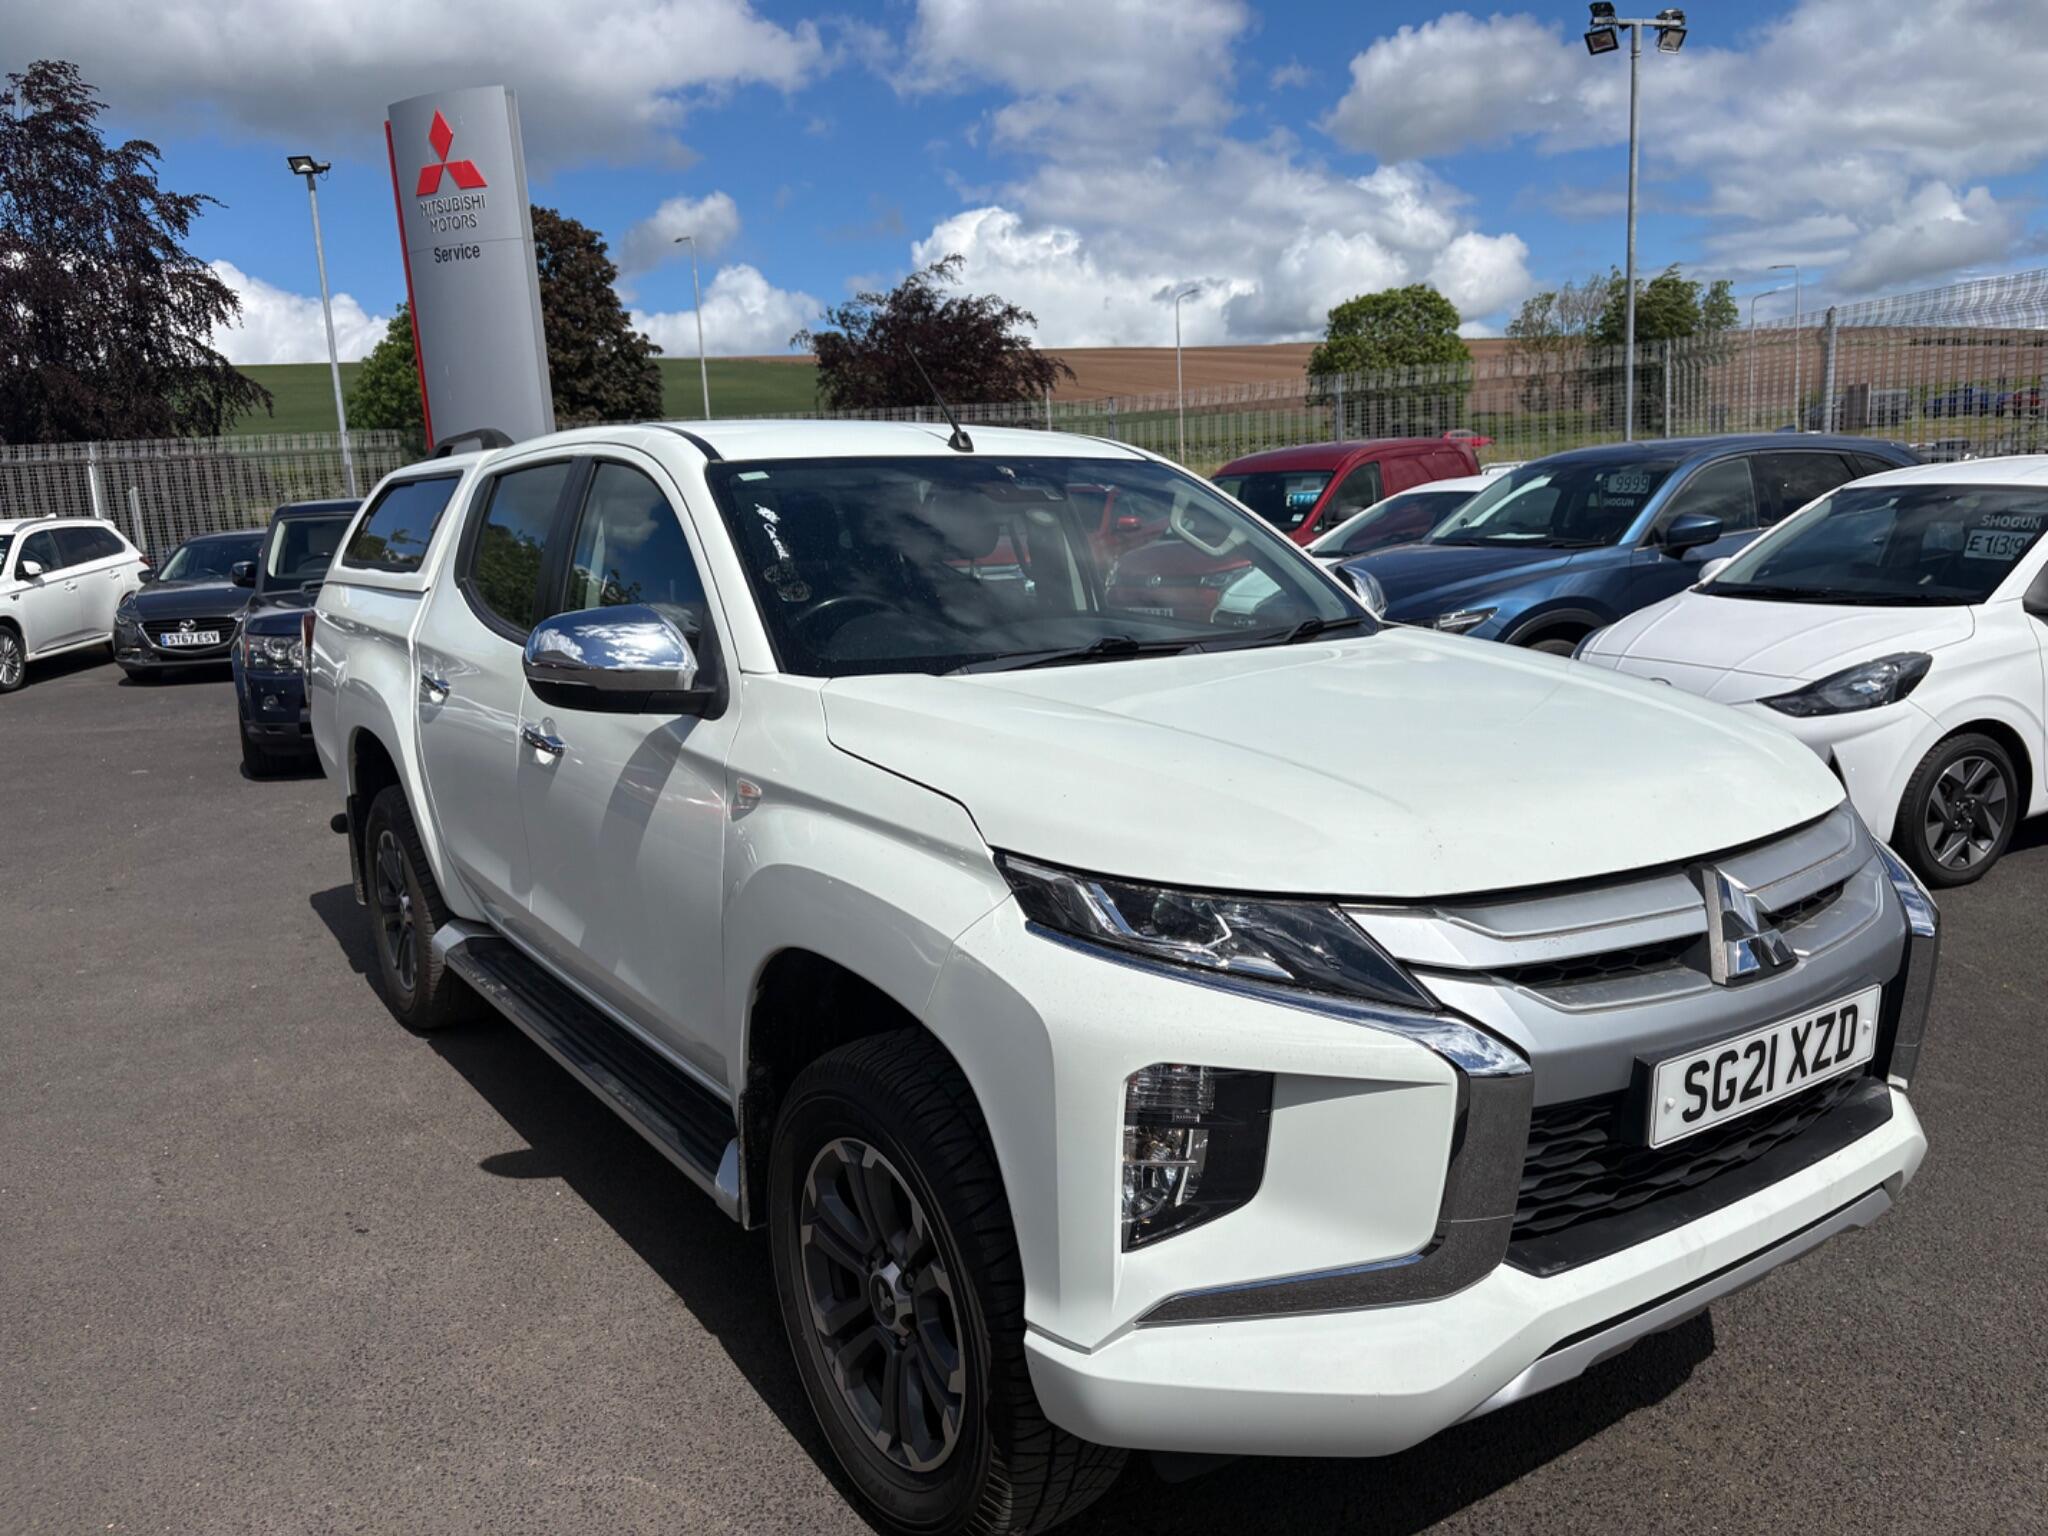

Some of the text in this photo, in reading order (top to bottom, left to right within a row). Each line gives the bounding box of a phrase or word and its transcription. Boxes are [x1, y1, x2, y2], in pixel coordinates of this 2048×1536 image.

[420, 193, 486, 216] MITSUBISHI
[430, 213, 478, 233] MOTORS
[434, 243, 480, 264] Service
[1980, 514, 2042, 529] SHOGUN
[168, 633, 217, 645] ST67 ESV
[1682, 1004, 1858, 1123] SG21 XZD
